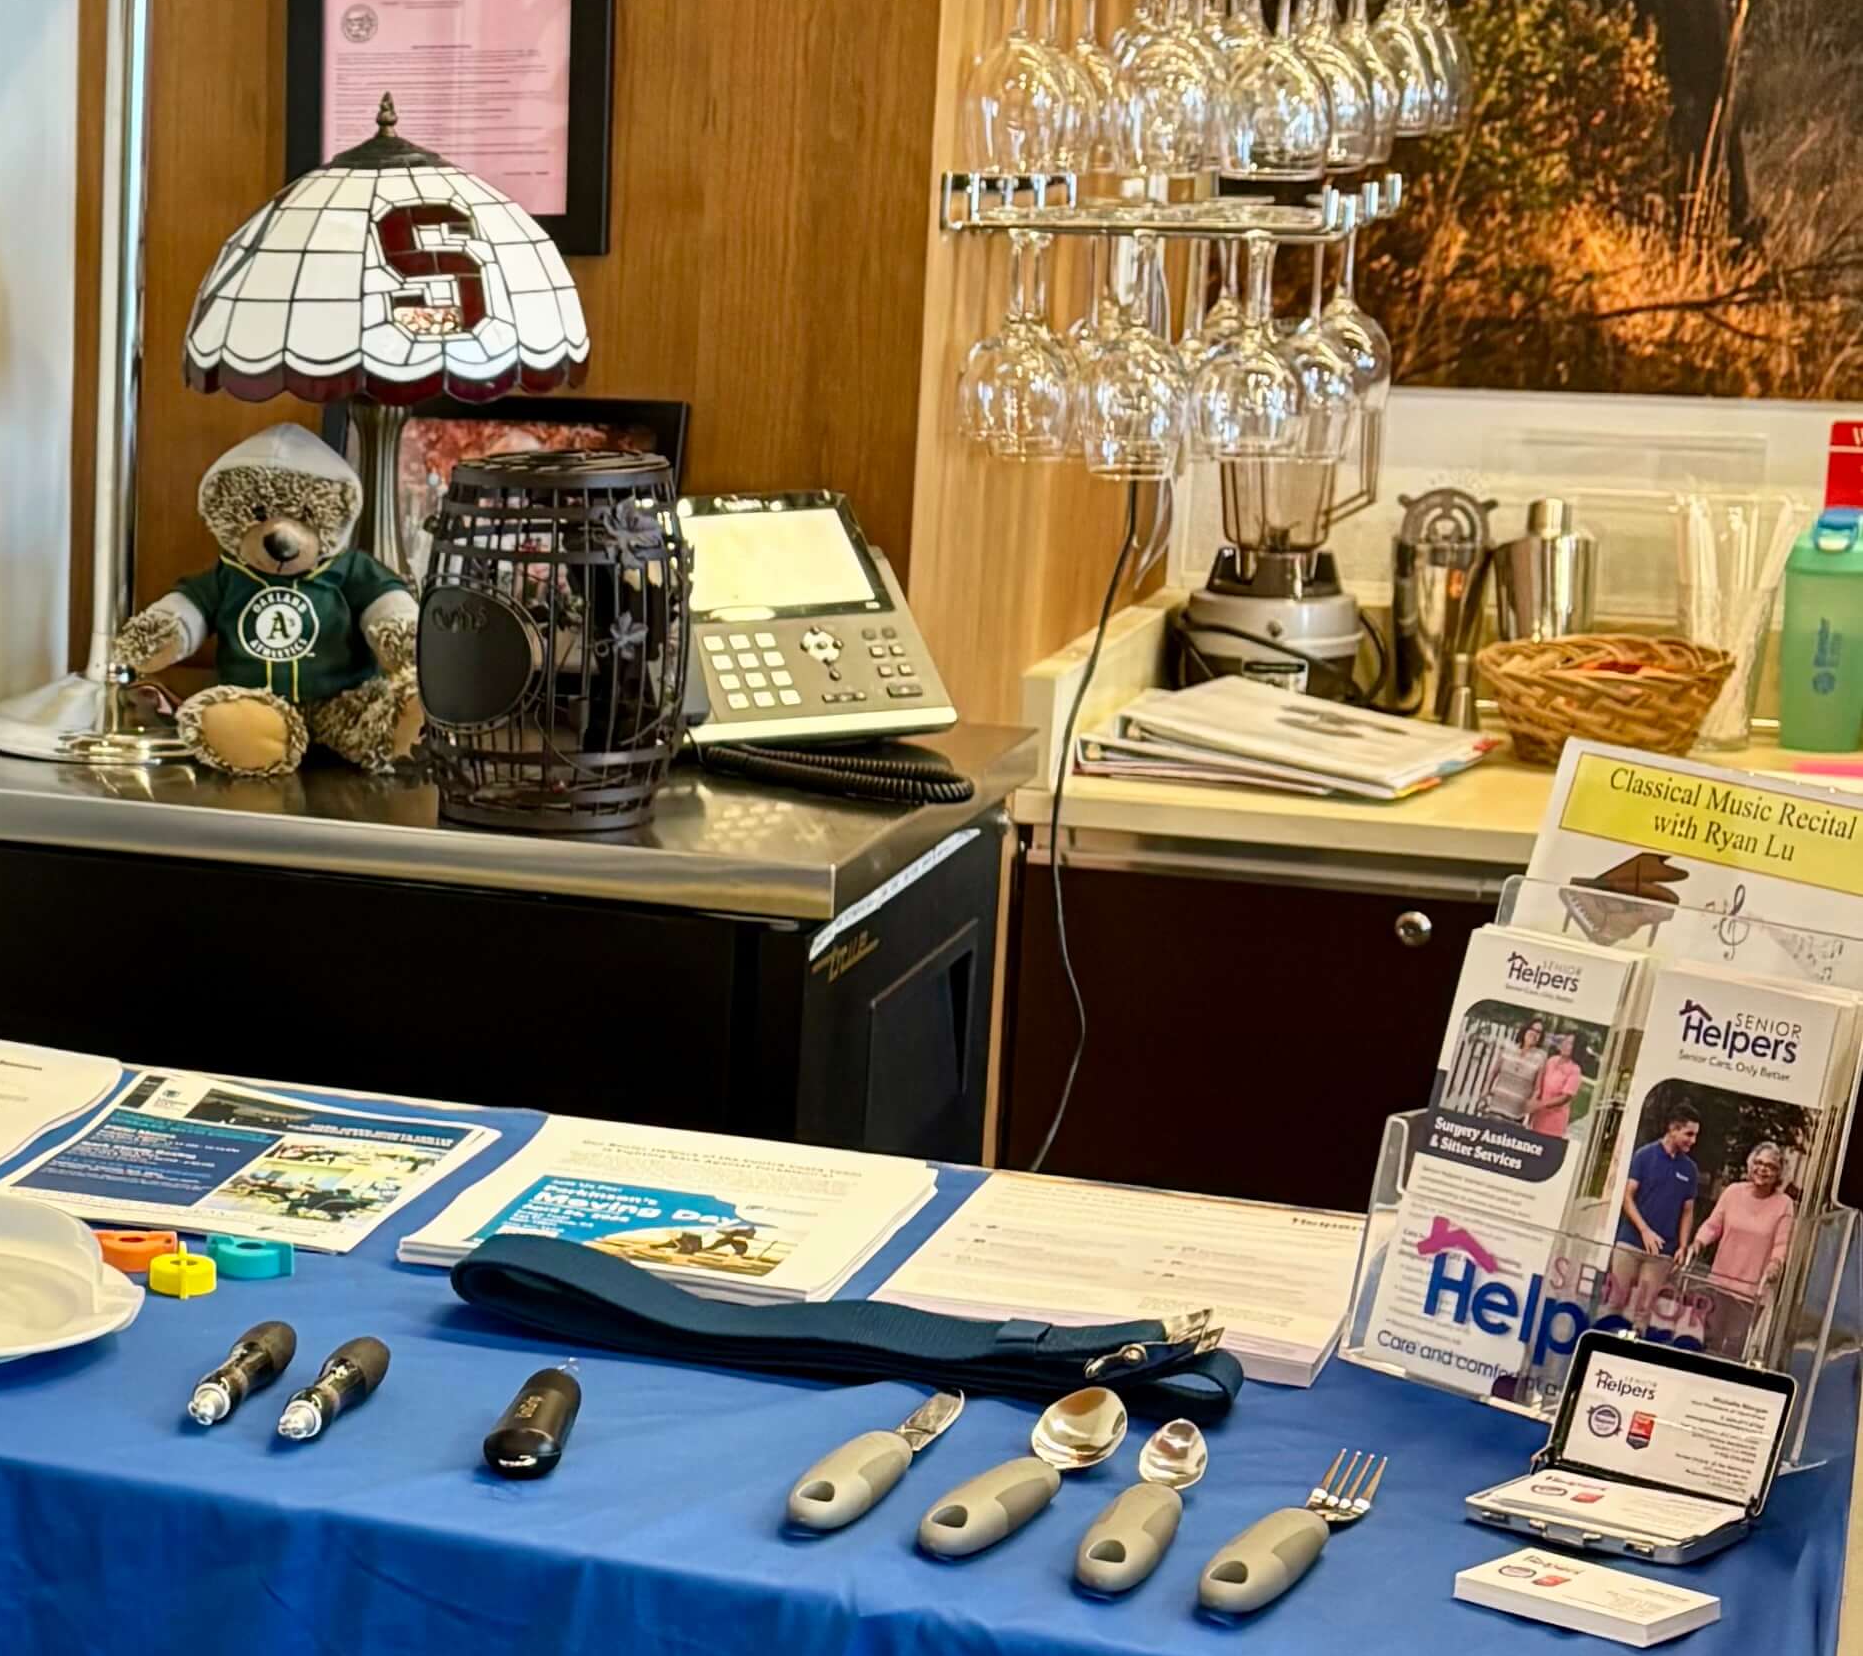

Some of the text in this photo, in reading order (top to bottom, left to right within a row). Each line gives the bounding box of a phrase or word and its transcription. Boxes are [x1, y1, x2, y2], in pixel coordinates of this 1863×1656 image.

[251, 591, 308, 614] OAKLAND
[1610, 767, 1858, 841] Classical Music Recital
[1654, 812, 1795, 862] with Ryan Lu
[1508, 961, 1580, 994] Helpers
[1682, 1014, 1798, 1065] Helpers
[1735, 1013, 1802, 1039] SENIOR
[1429, 1134, 1523, 1170] & Sitter Services
[1435, 1116, 1544, 1157] Surgery Assistance
[532, 1190, 662, 1221] Moving
[671, 1208, 741, 1228] Day
[543, 1184, 658, 1207] Parkinson's
[1549, 1256, 1716, 1330] SENIOR
[1377, 1330, 1418, 1355] Care
[1419, 1341, 1453, 1368] and
[1596, 1375, 1656, 1401] Helpers
